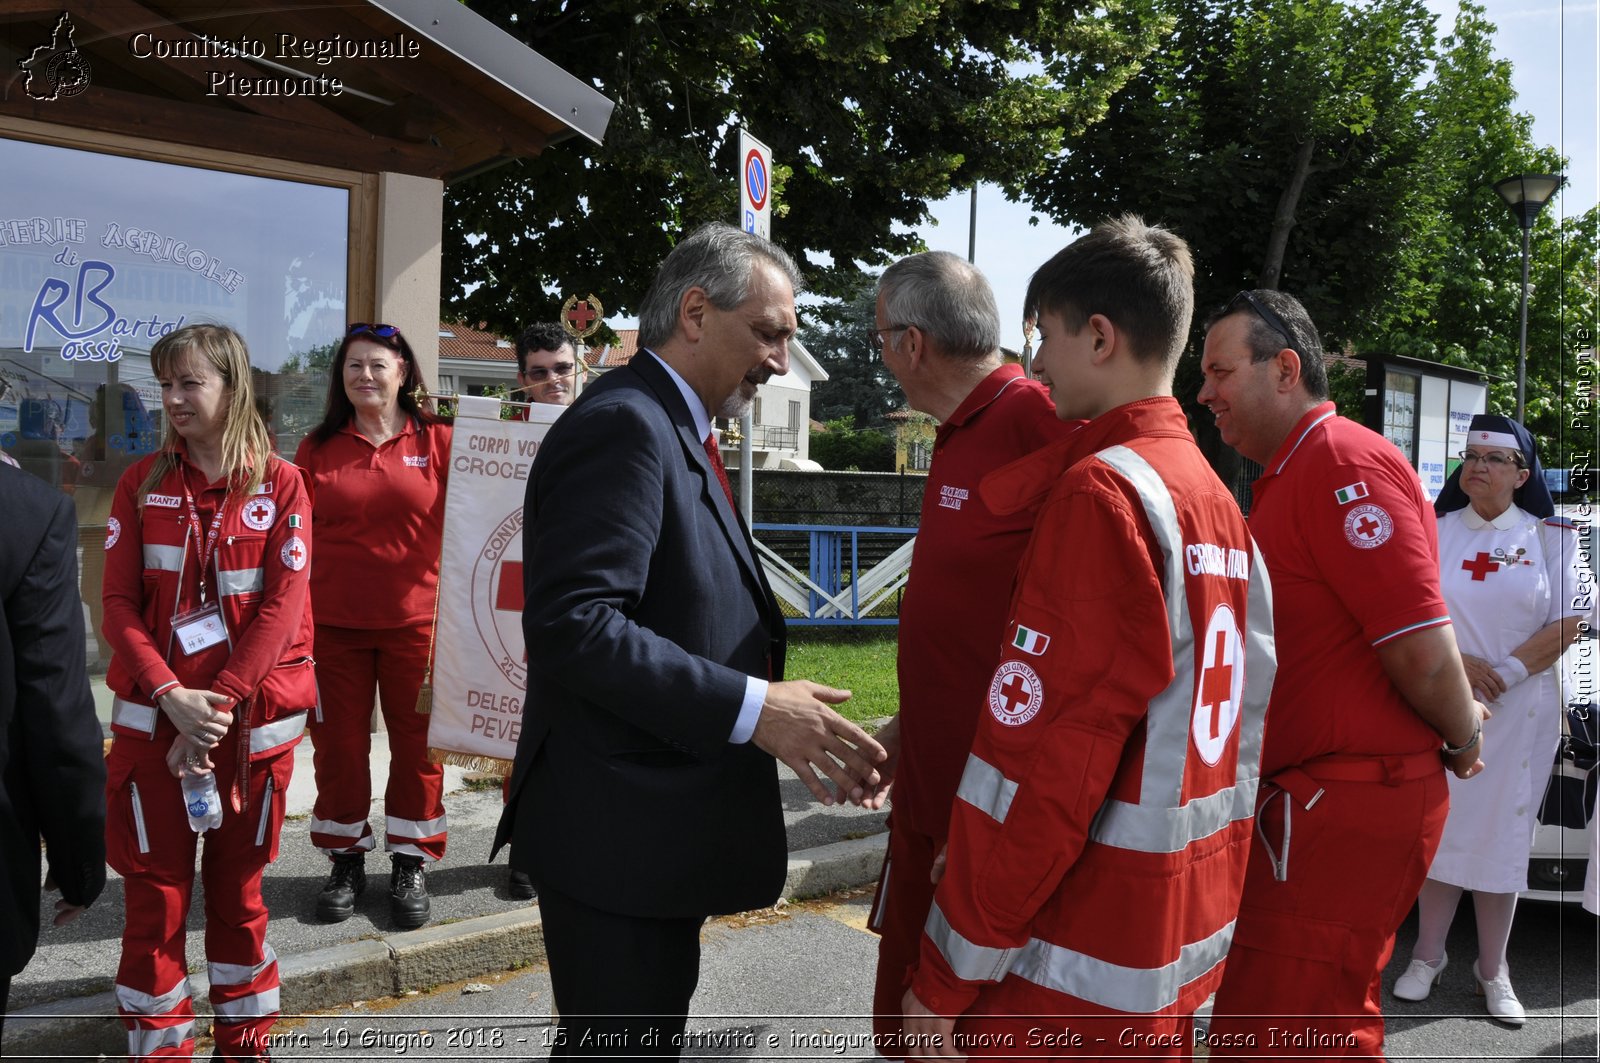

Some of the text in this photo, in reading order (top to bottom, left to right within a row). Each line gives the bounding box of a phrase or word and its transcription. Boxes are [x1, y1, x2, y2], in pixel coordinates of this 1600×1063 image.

[53, 245, 80, 267] di
[101, 221, 248, 295] AGRICOLE
[469, 434, 510, 455] CORPO
[454, 455, 529, 481] CROCE
[149, 495, 179, 507] MANTA
[1012, 662, 1040, 685] GINEVRA
[990, 667, 1005, 718] CONVENZIONE
[1023, 693, 1042, 720] AGOSTO
